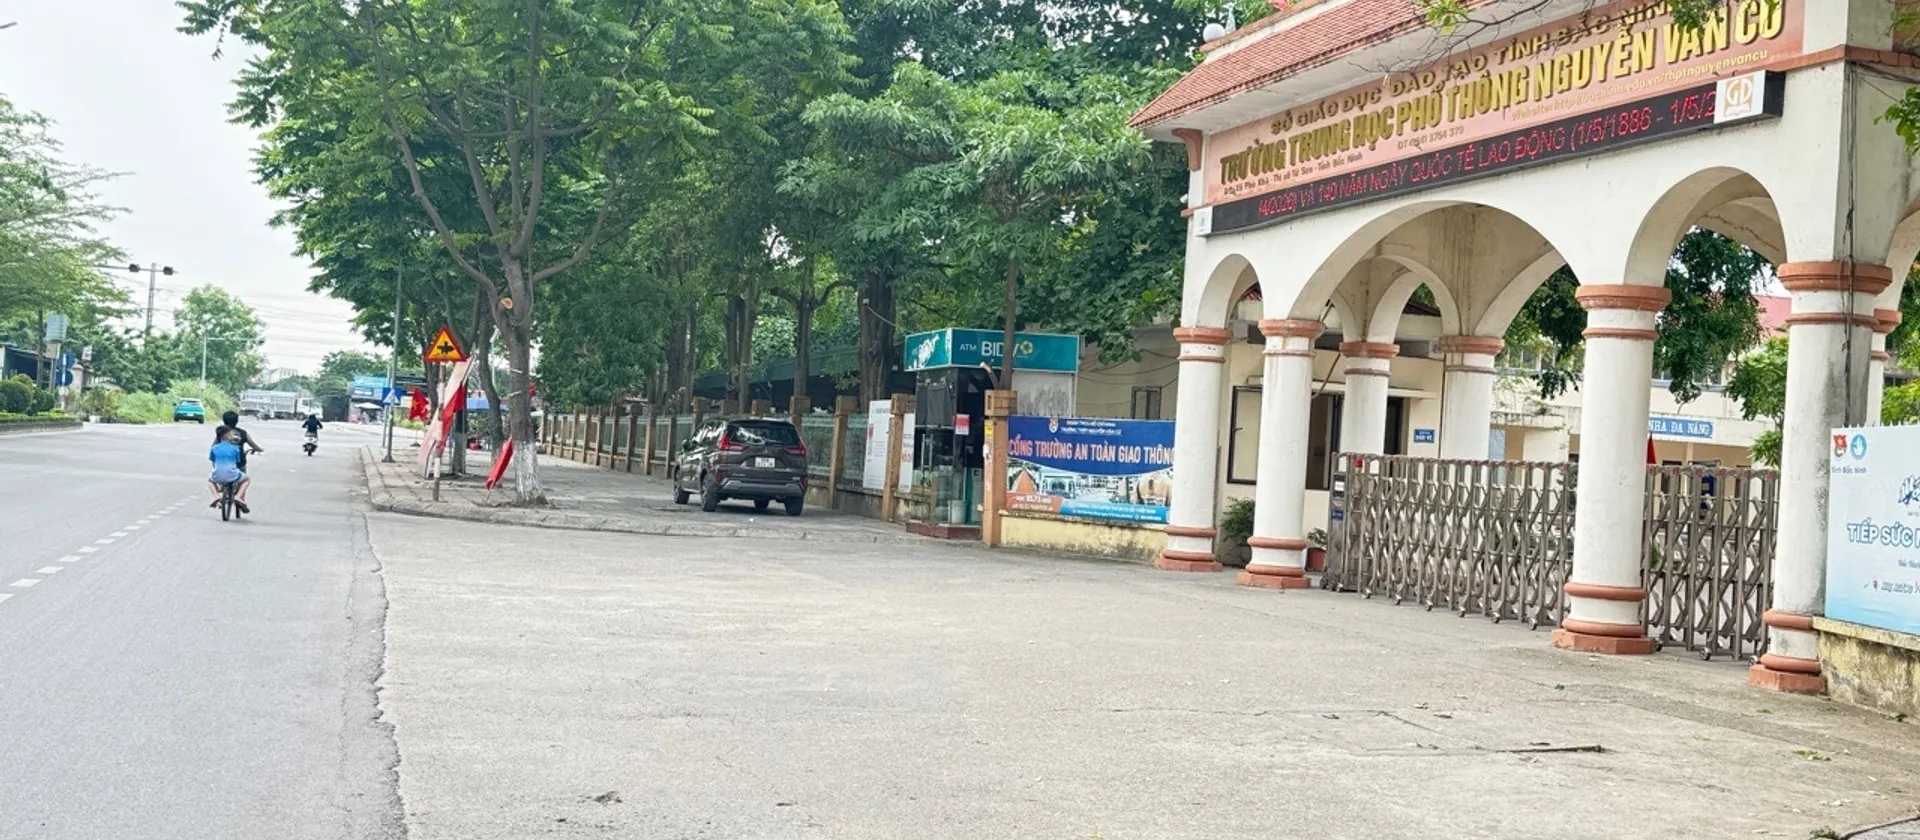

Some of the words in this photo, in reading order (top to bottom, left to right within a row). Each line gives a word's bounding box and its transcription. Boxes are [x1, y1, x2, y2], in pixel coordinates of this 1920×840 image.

[1271, 109, 1293, 135] SỞ
[1297, 100, 1338, 127] GIÁO
[1494, 32, 1550, 65] TỈNH
[1620, 0, 1673, 25] NIN
[1220, 138, 1286, 185] TRƯỜNG
[1288, 119, 1350, 165] TRUNG
[1352, 105, 1394, 150] HỌC
[1396, 80, 1444, 136] PHỔ
[1446, 64, 1529, 122] THÔNG
[1534, 24, 1656, 101] NGUYỄN
[1319, 181, 1336, 202] 140
[1410, 153, 1452, 182] QUỐC
[1479, 140, 1510, 166] LAO
[1515, 130, 1565, 160] ĐỘNG
[959, 343, 977, 352] ATM
[1671, 421, 1683, 434] ĐA
[1008, 434, 1033, 457] CỔNG
[1035, 438, 1072, 459] TRƯỜNG
[1074, 443, 1088, 460] AN
[1118, 445, 1141, 464] GIAO
[1847, 516, 1879, 544] TIẾP
[1880, 521, 1914, 548] SỨC
